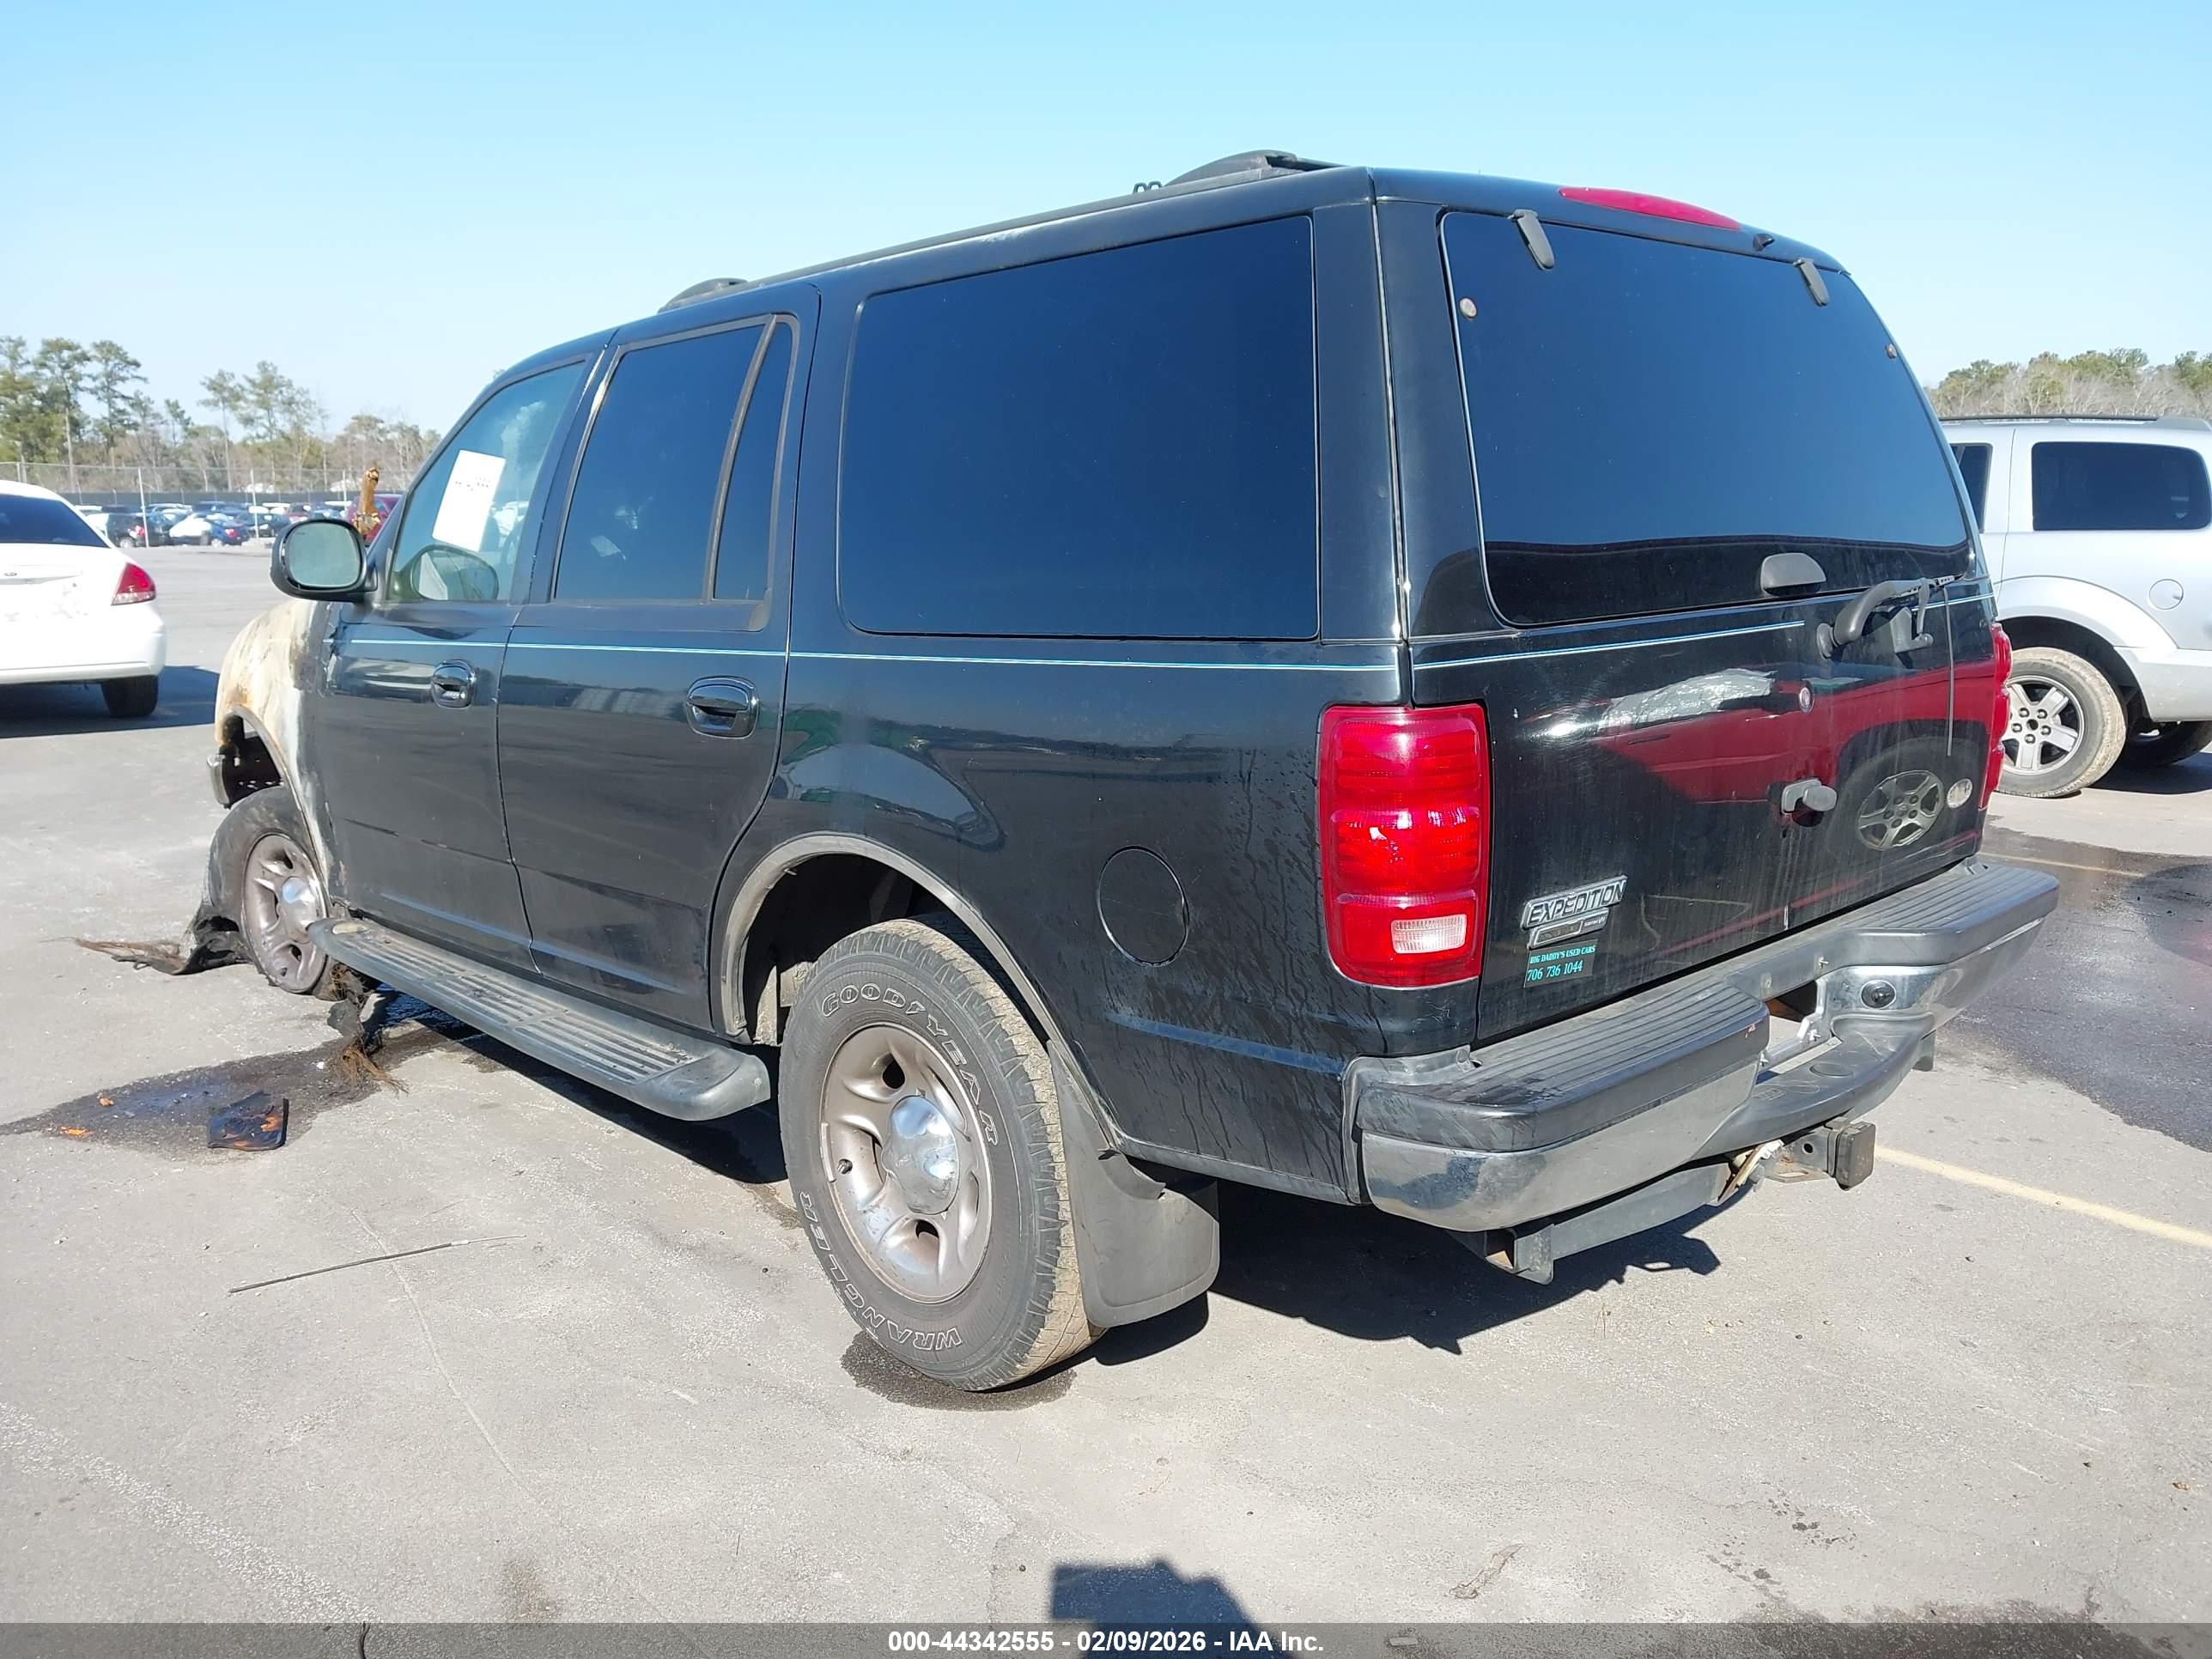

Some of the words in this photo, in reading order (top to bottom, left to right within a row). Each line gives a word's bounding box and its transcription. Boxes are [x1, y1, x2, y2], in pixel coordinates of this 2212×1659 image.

[1528, 880, 1626, 924] EXPEDITION
[1528, 968, 1543, 981] 706
[1546, 964, 1561, 977] 736
[1564, 960, 1583, 974] 1044
[1541, 951, 1565, 961] DADDY'S
[822, 983, 998, 1146] GOODYEAR
[799, 1191, 963, 1350] WRANGLER
